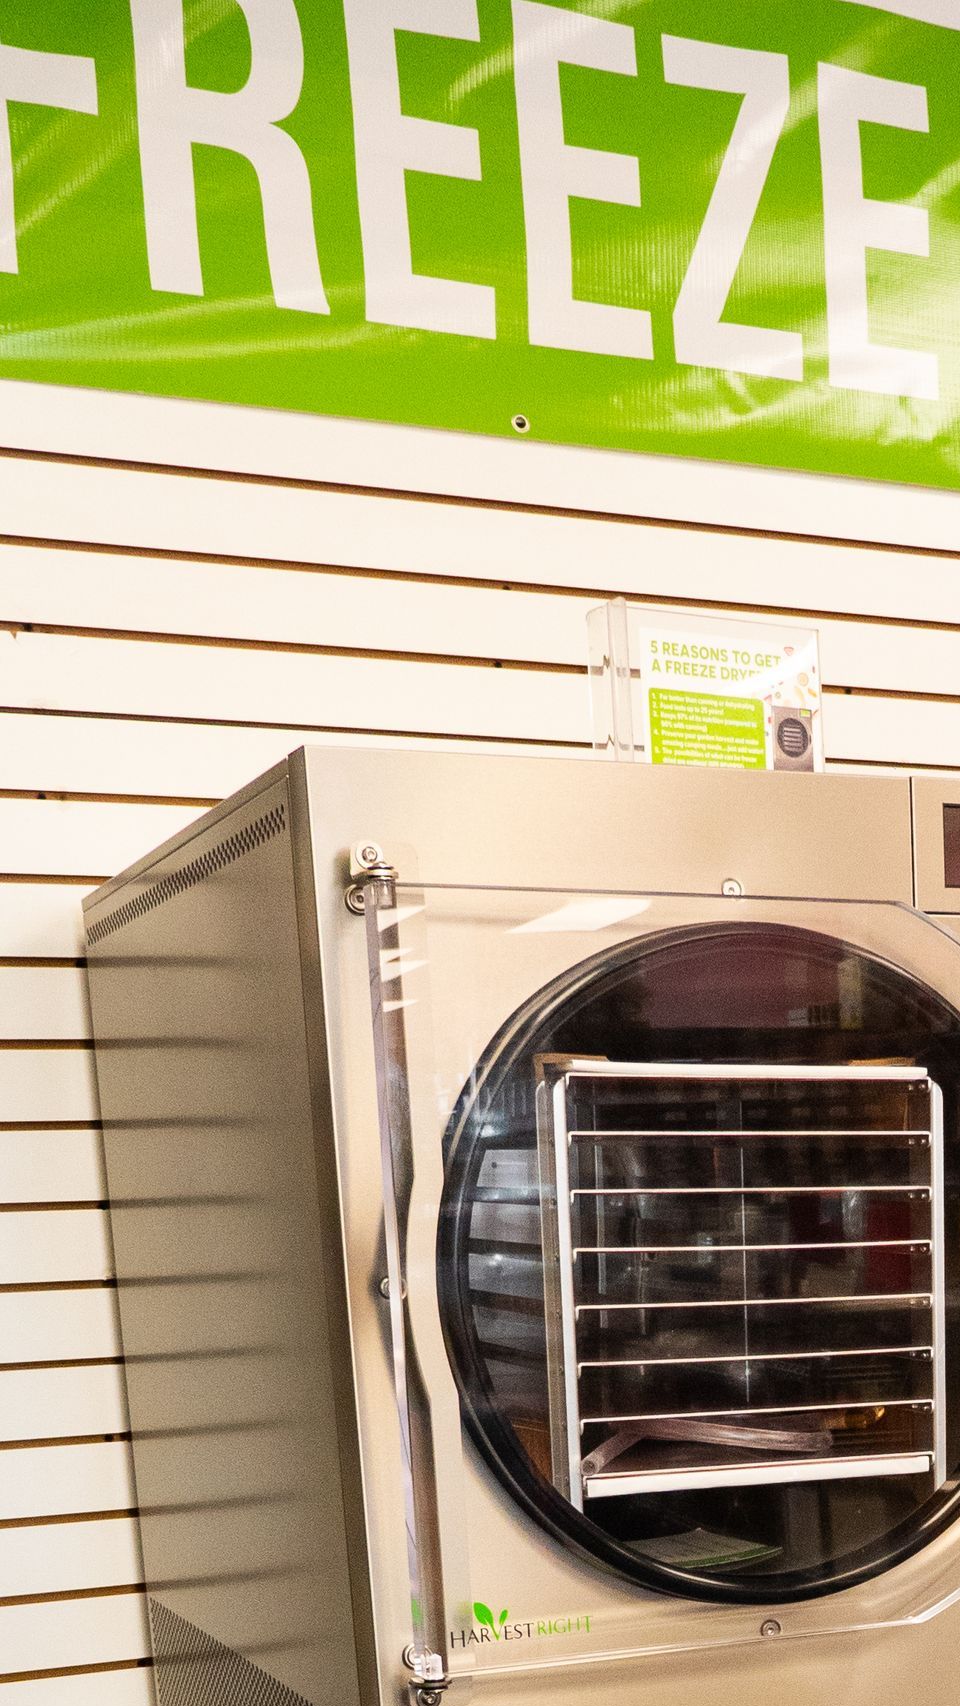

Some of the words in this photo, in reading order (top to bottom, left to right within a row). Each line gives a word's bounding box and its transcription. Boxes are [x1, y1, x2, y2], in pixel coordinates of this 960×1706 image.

[0, 0, 940, 400] REEZE
[650, 640, 658, 653] 5
[662, 641, 729, 662] REASONS
[731, 650, 751, 665] TO
[754, 653, 782, 668] GET
[651, 658, 661, 672] A
[665, 660, 717, 679] FREEZE
[720, 666, 761, 681] DRY
[450, 1604, 593, 1649] HARVESTRIGHT
